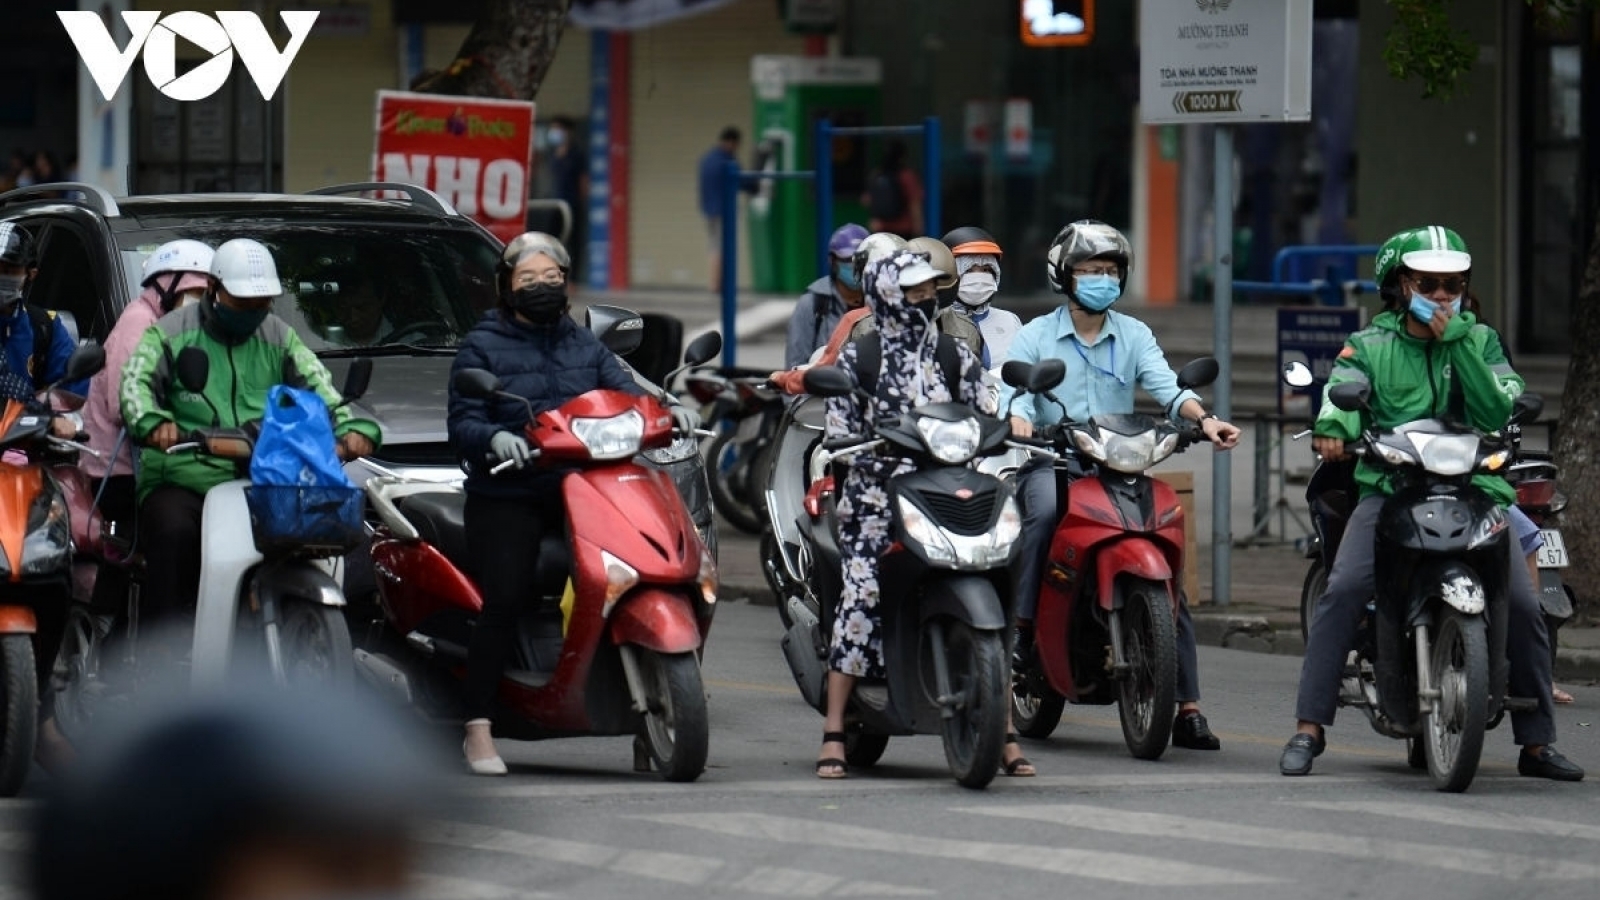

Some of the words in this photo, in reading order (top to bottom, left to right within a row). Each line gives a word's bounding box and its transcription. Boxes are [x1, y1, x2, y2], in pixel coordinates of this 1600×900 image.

[1190, 94, 1218, 111] 1000
[1219, 93, 1230, 109] M
[1375, 248, 1395, 275] Grab
